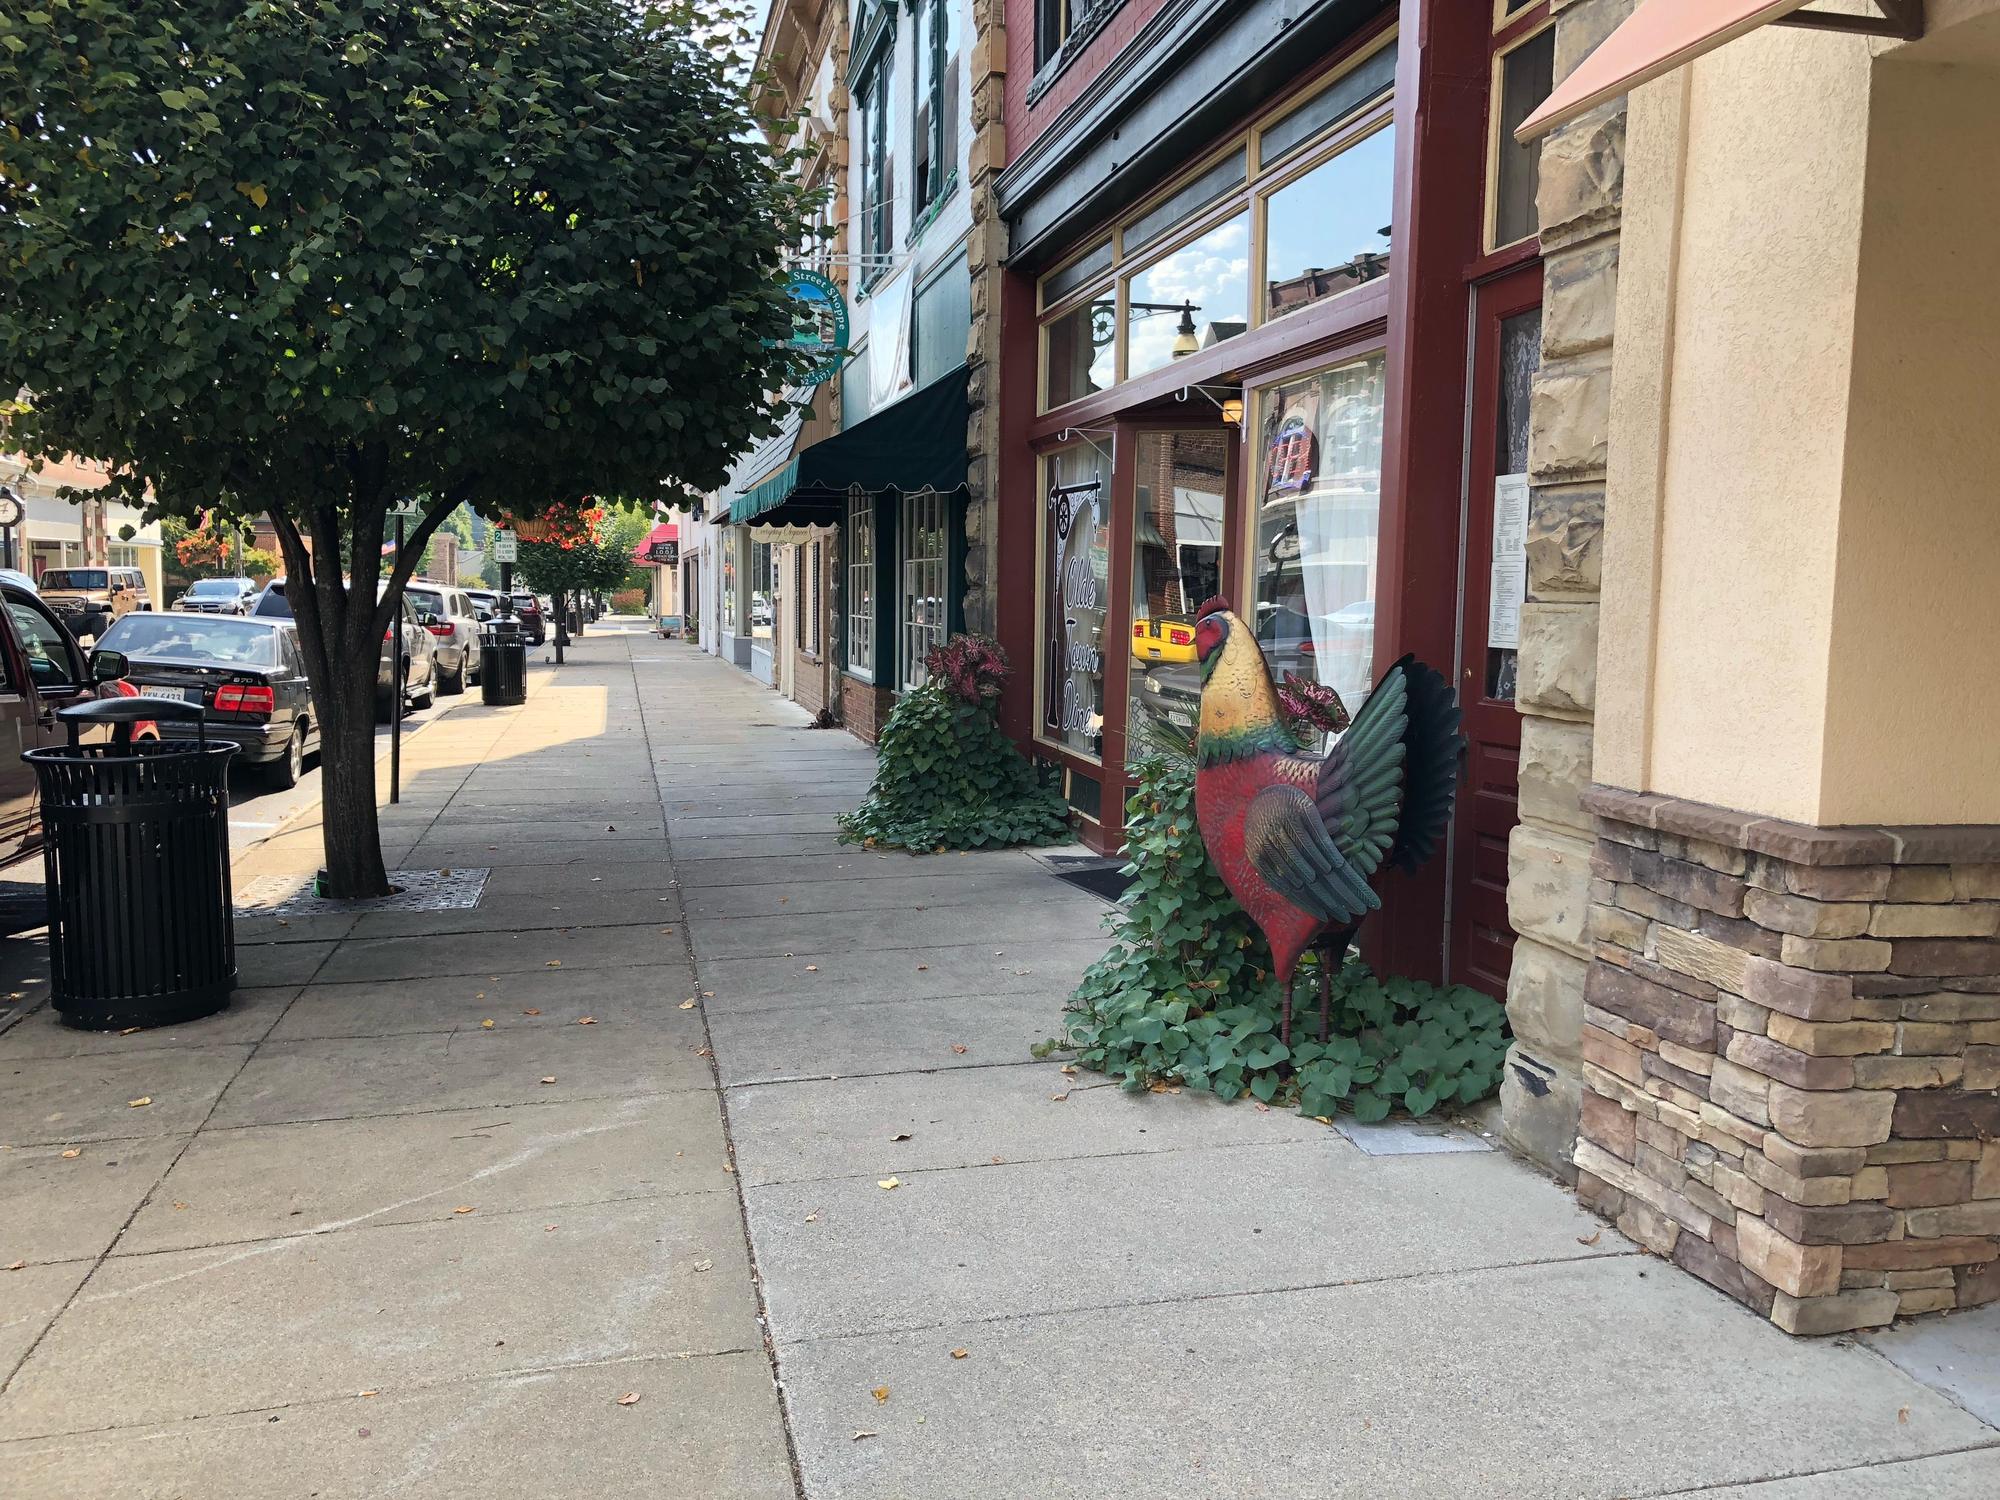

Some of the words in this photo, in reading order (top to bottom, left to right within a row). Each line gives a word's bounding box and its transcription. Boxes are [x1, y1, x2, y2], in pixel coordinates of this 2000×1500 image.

[793, 271, 826, 289] Street
[827, 287, 845, 331] Shoppe
[496, 532, 500, 540] 2
[1066, 556, 1097, 609] Olde
[1065, 618, 1099, 673] Town
[1062, 678, 1098, 737] Diner
